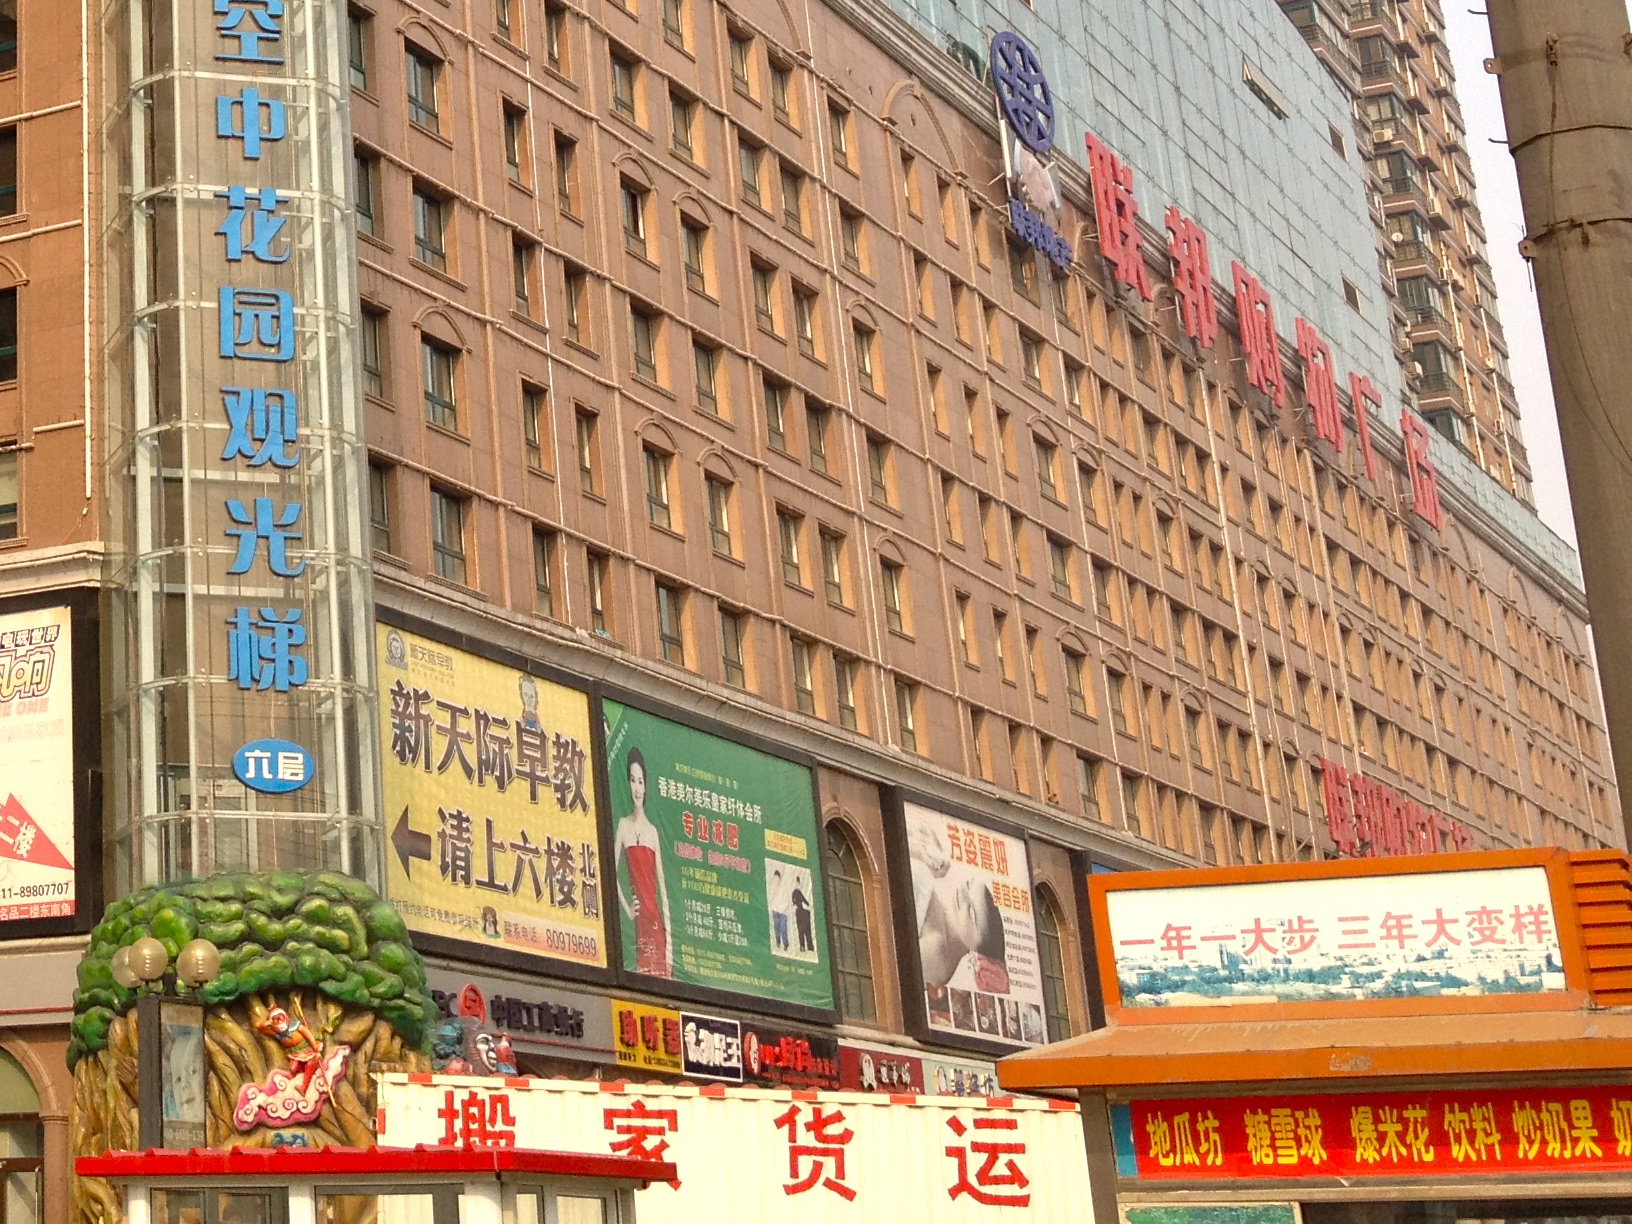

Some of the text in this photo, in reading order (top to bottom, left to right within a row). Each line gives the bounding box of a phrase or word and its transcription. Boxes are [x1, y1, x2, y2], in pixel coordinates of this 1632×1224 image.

[1085, 131, 1443, 533] 联邦购物广场
[1, 625, 59, 648] 电玩世界
[16, 697, 50, 717] ONE
[243, 748, 307, 781] 六层
[390, 679, 590, 815] 新天际早教
[437, 805, 579, 911] 请上六楼
[545, 927, 598, 957] 80979699
[1119, 902, 1553, 960] 一年一大步 三年大变样
[1146, 1110, 1223, 1167] 地瓜坊
[1244, 1106, 1328, 1166] 糖雪球
[1351, 1103, 1435, 1164] 爆米花
[1444, 1101, 1503, 1162] 饮料
[1512, 1098, 1603, 1159] 炒奶果
